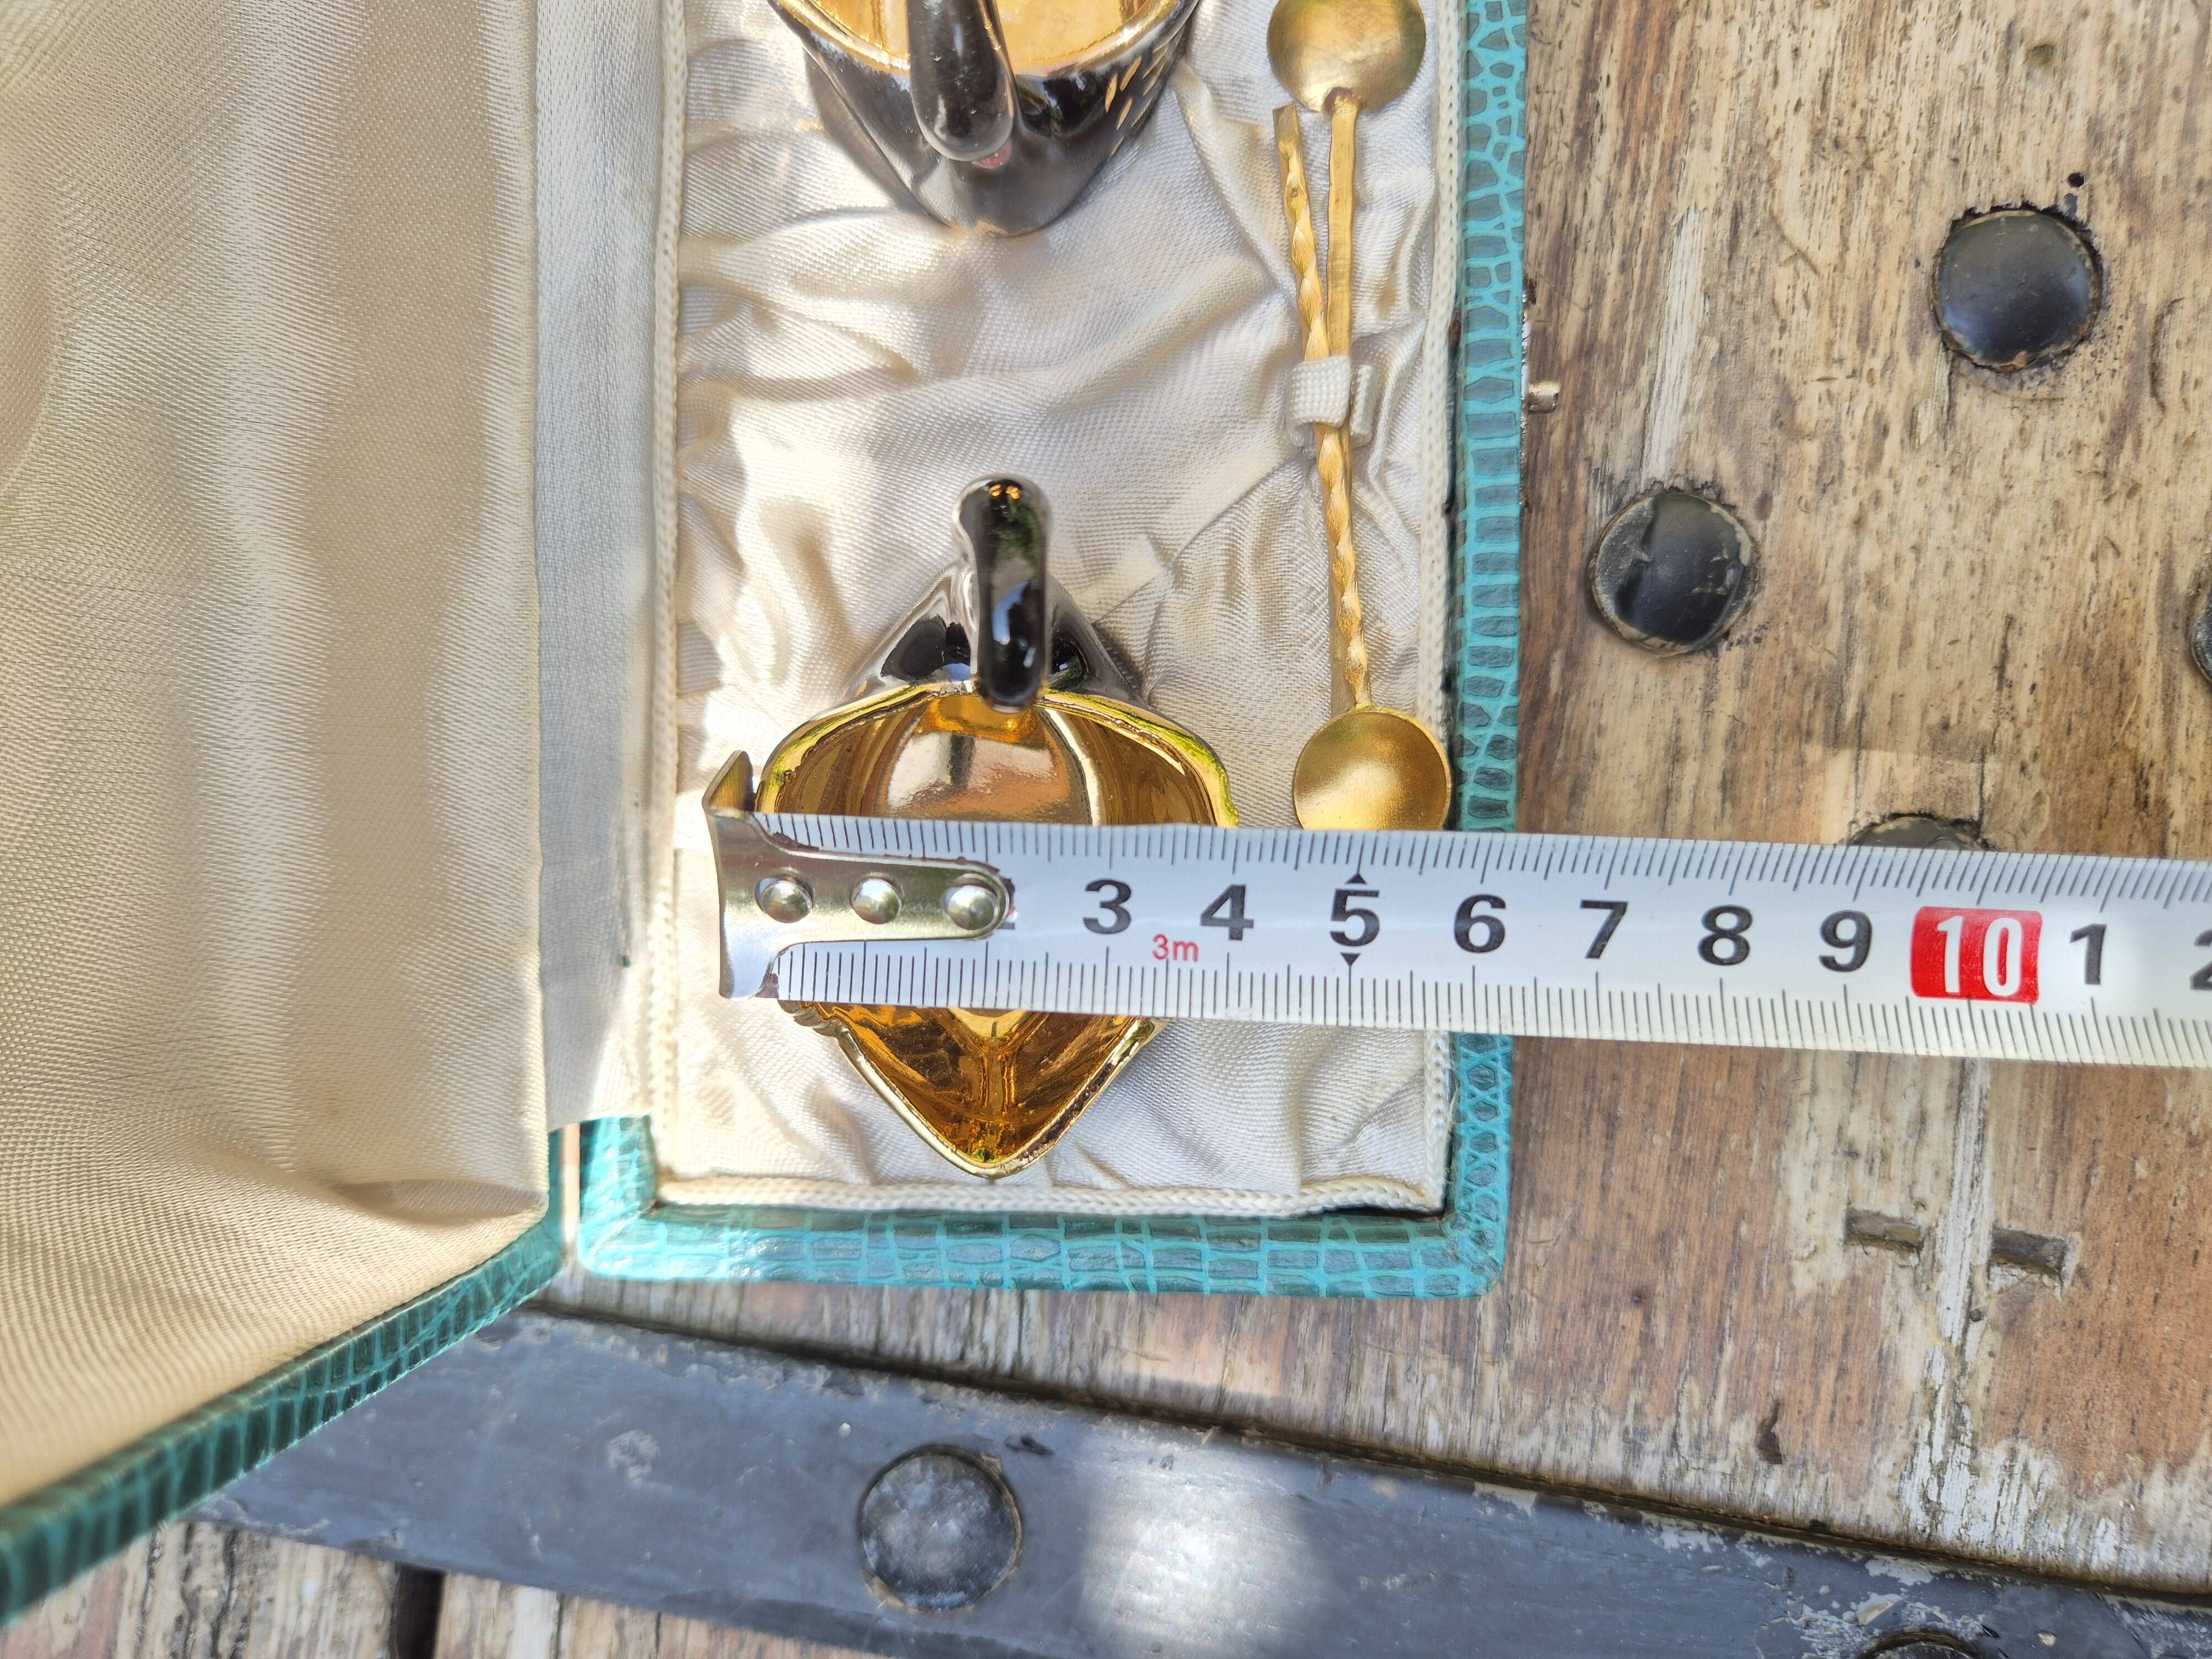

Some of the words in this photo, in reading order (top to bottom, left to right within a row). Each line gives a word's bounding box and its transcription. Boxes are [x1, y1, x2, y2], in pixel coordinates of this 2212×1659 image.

[1082, 878, 1132, 935] 3
[1200, 884, 1254, 941] 4
[1329, 889, 1380, 947] 5
[1453, 893, 1506, 953] 6
[1579, 899, 1629, 959] 7
[1698, 904, 1753, 966] 8
[1818, 910, 1873, 973] 9
[1936, 915, 2022, 997] 10
[2069, 923, 2107, 985] 1
[1151, 934, 1199, 962] 3m
